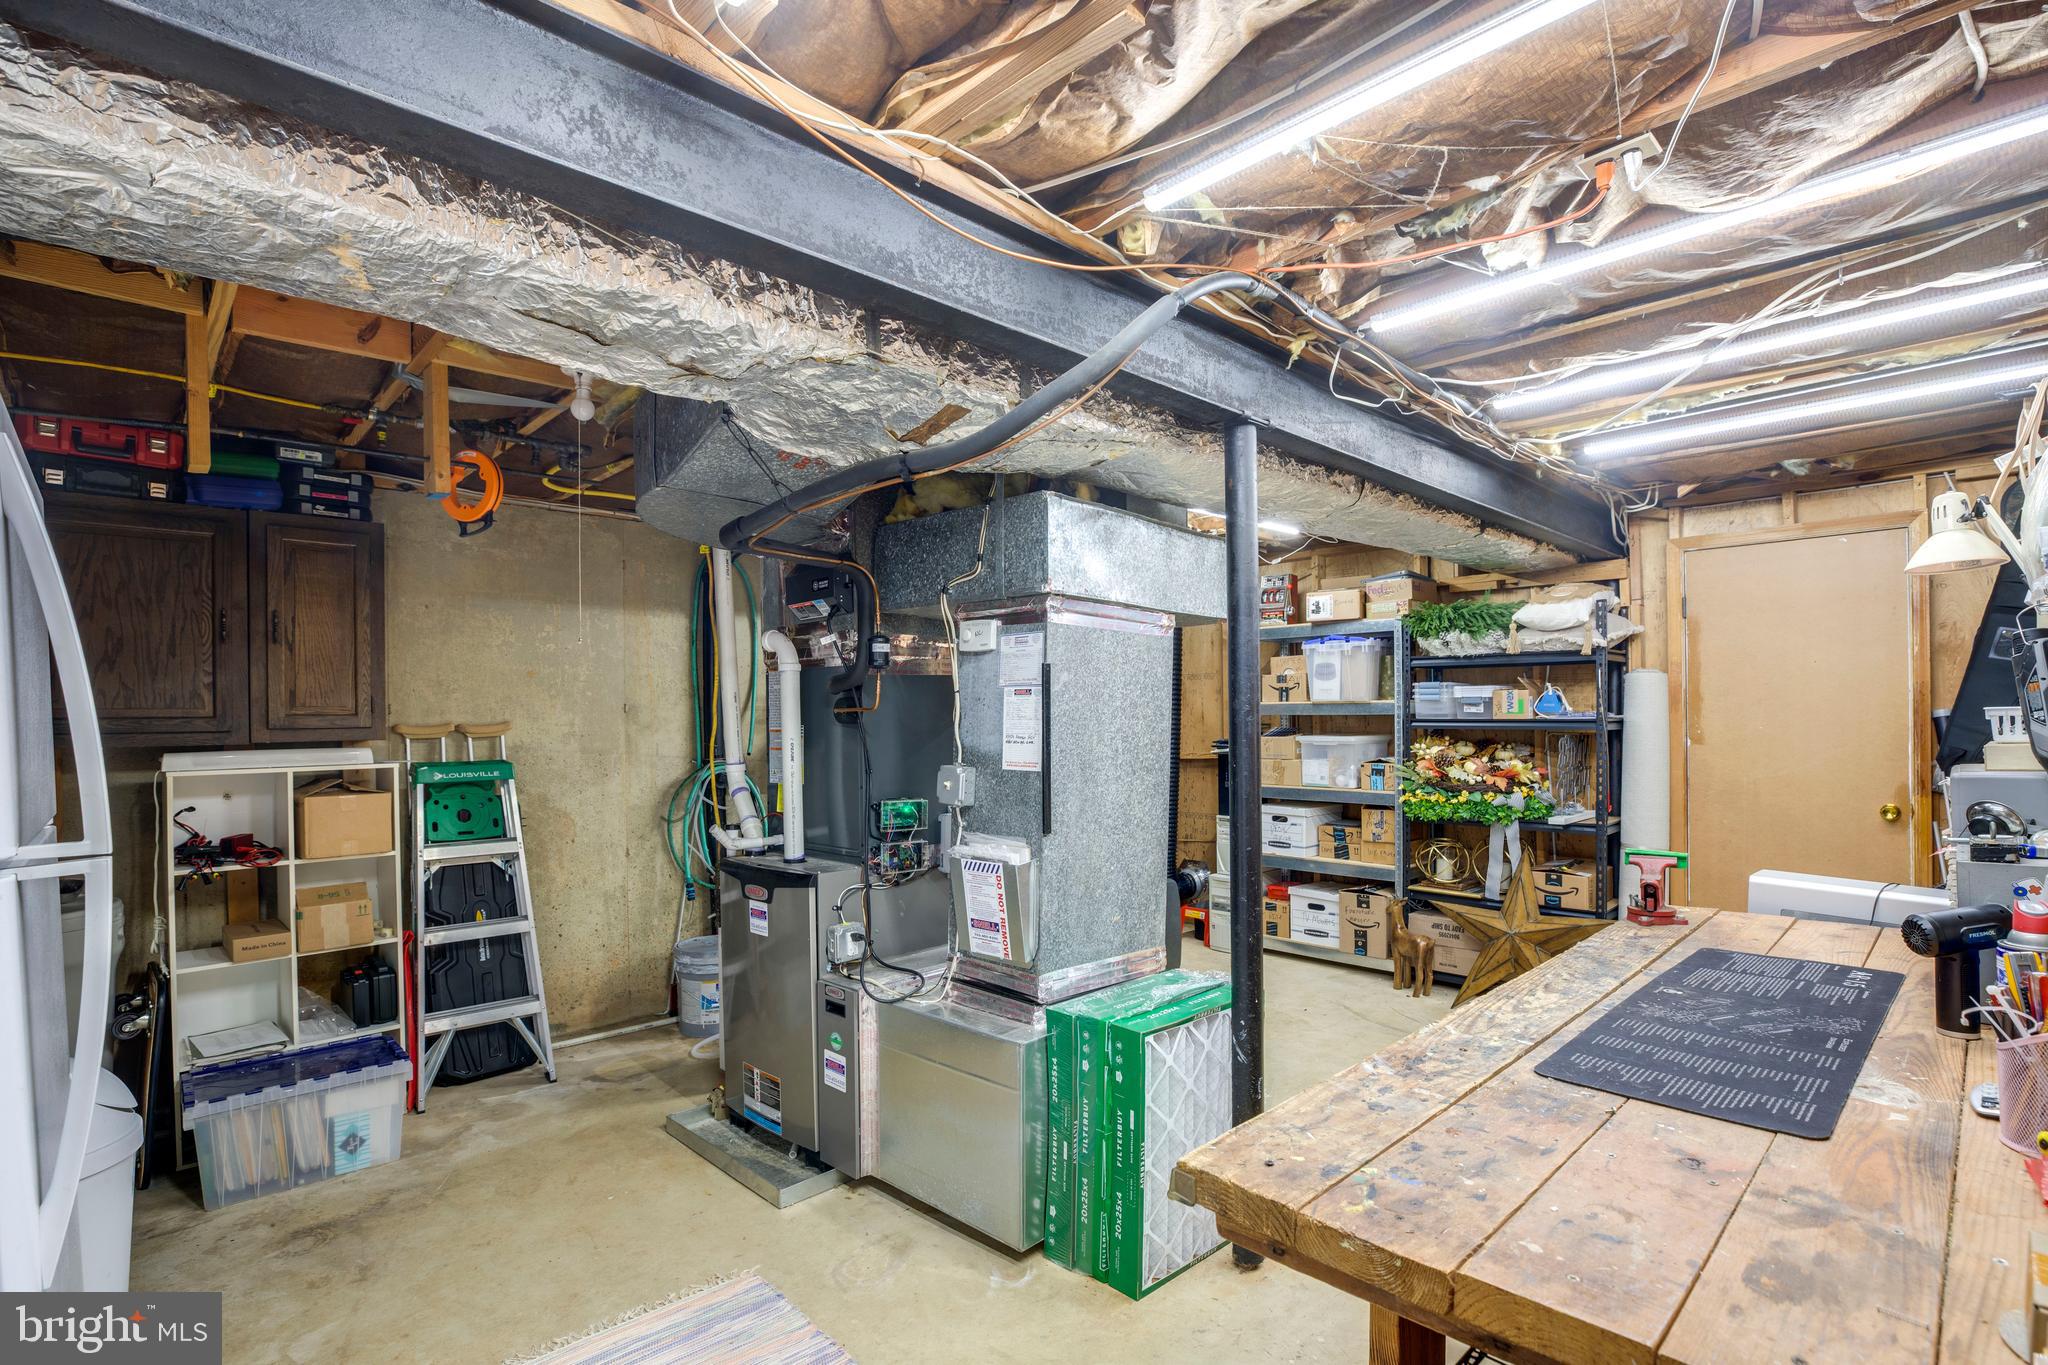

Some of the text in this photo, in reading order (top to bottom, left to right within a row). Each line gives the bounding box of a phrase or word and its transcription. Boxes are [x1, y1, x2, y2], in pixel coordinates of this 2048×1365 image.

[443, 771, 501, 779] LOUISVILLE
[996, 875, 1010, 960] DO NOT REMOVE
[268, 940, 286, 948] China
[1081, 1177, 1089, 1224] 20x25x4
[1115, 1191, 1123, 1240] 20x25x4
